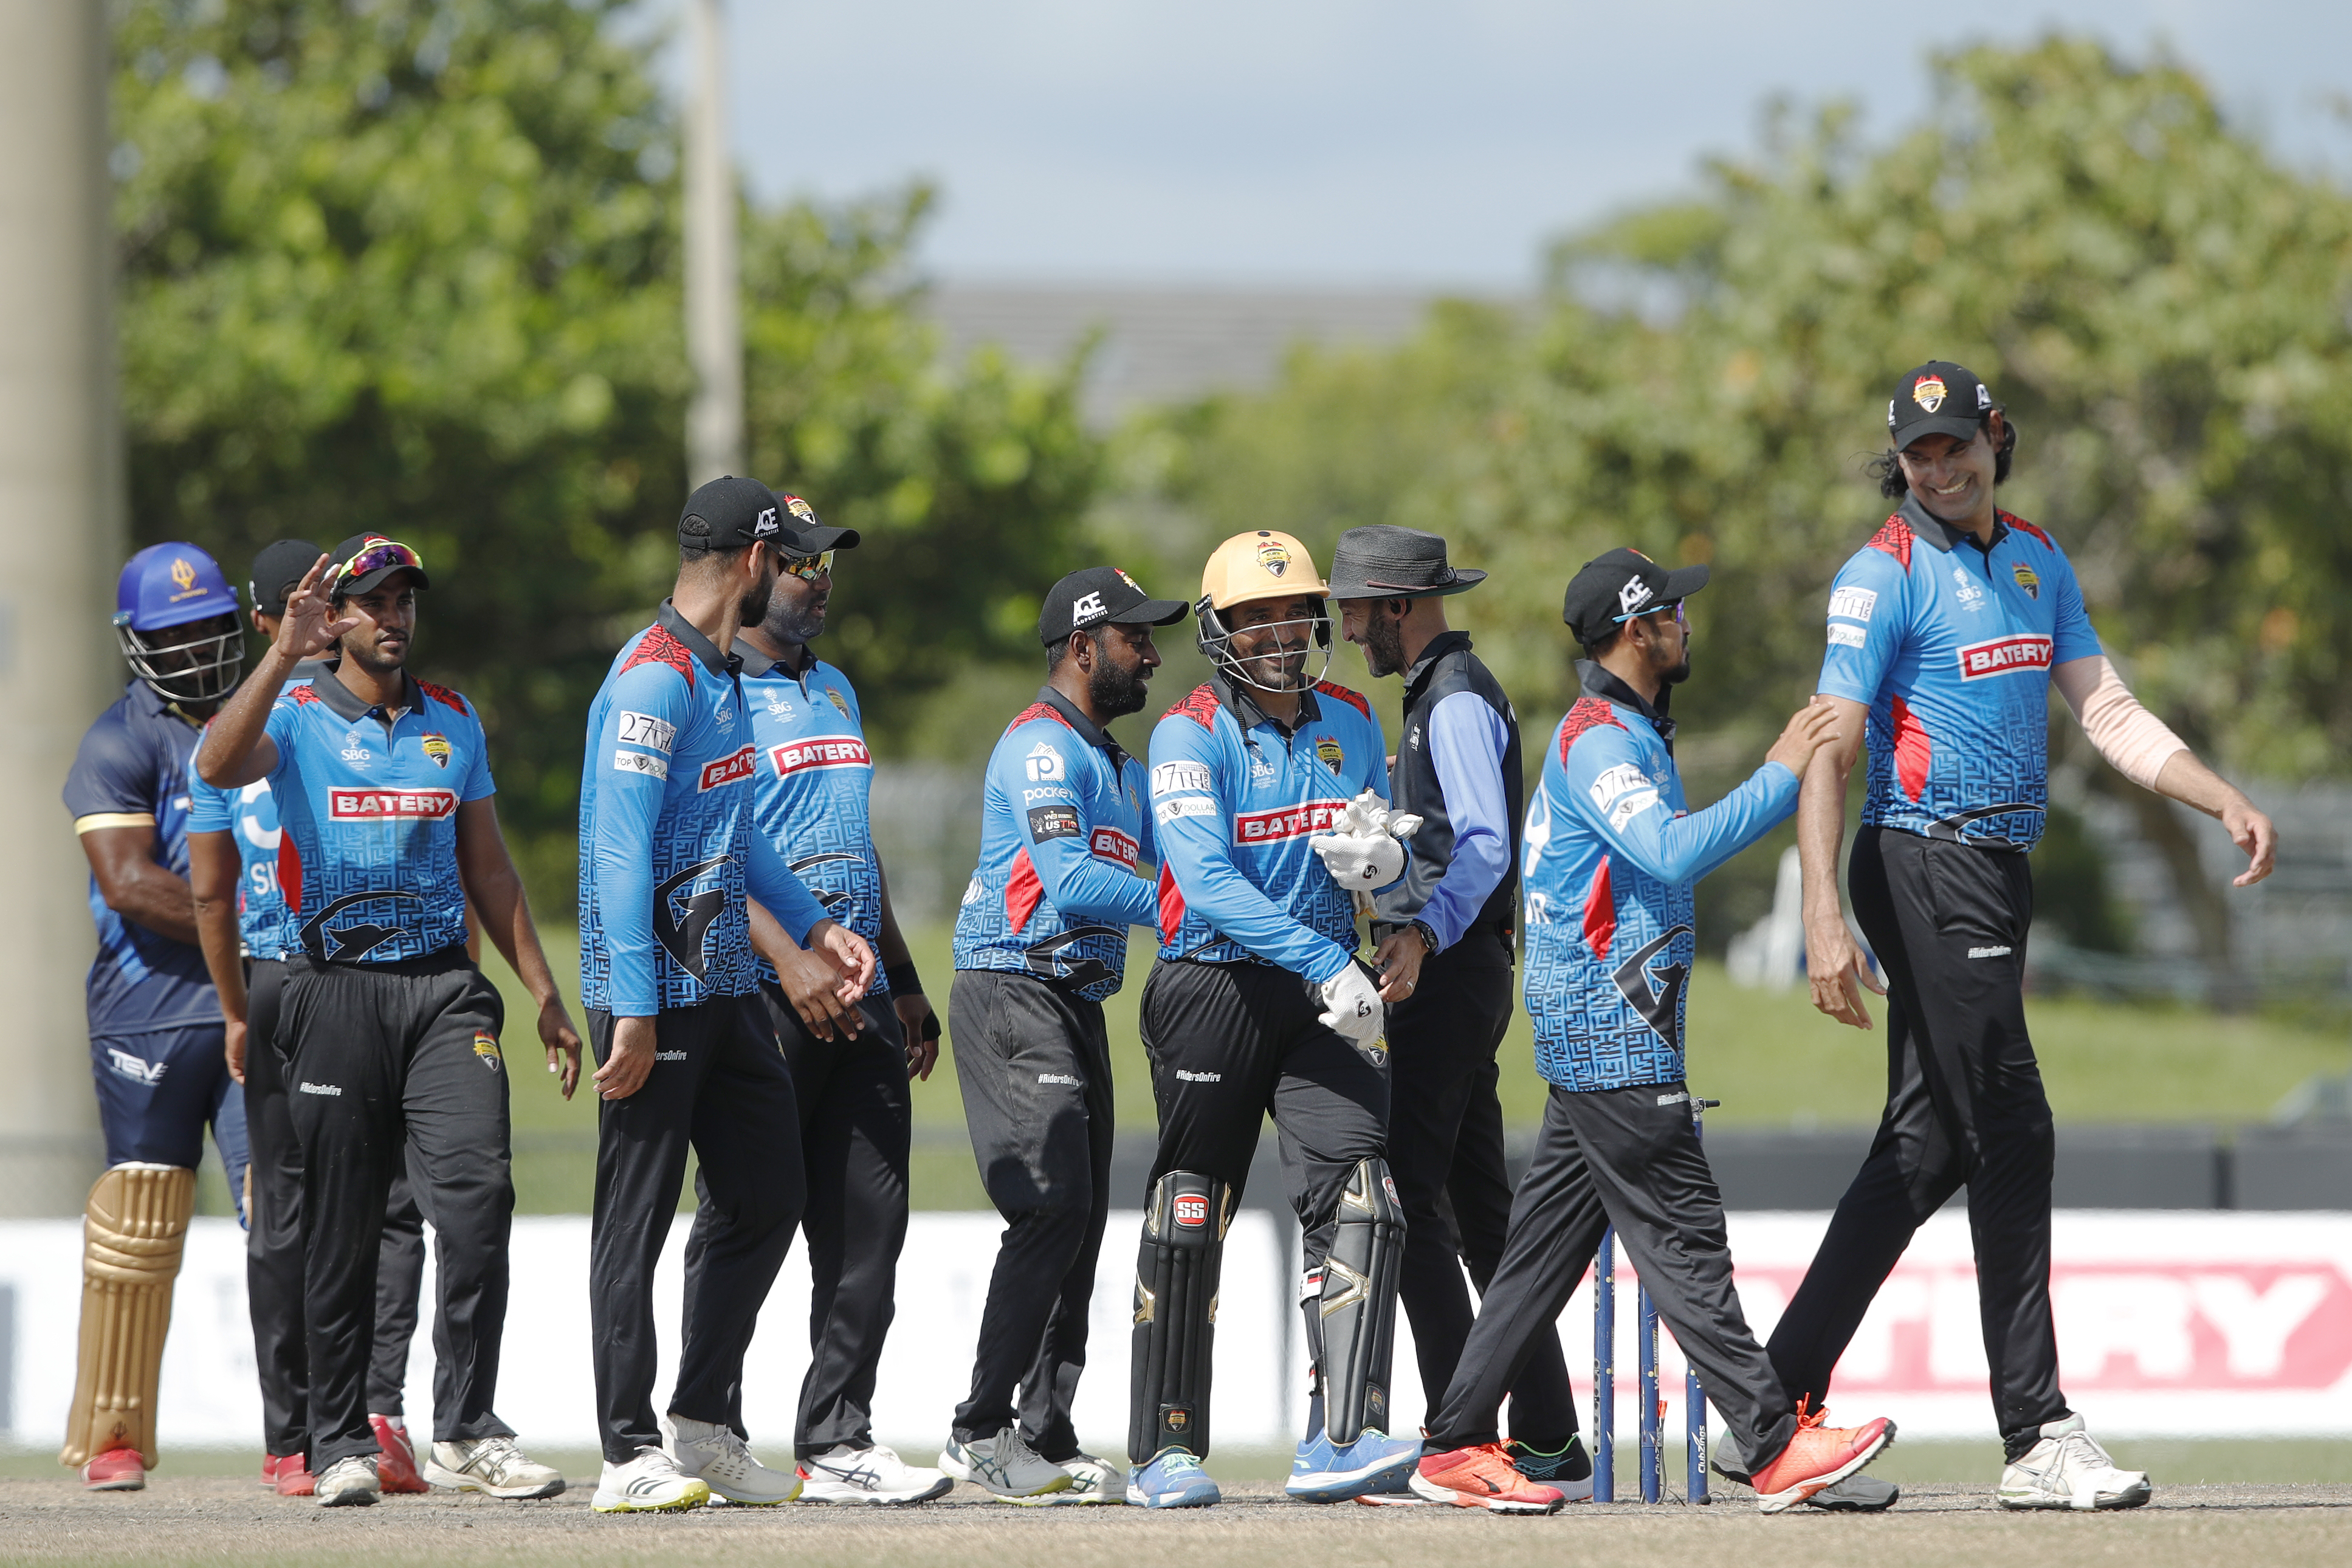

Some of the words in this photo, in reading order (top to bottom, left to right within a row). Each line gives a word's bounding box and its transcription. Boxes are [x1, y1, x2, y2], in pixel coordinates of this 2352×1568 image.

[1956, 585, 1982, 603] SBG
[1969, 642, 2051, 672] BATERY
[768, 700, 793, 716] SBG
[341, 748, 371, 762] SBG
[616, 757, 632, 766] TOP
[781, 742, 865, 769] BATERY
[1250, 762, 1275, 779] SBG
[1152, 763, 1204, 796] 27TH
[337, 795, 451, 813] BATERY
[1175, 1069, 1222, 1082] #RidersOnFire
[1177, 1202, 1205, 1219] SS
